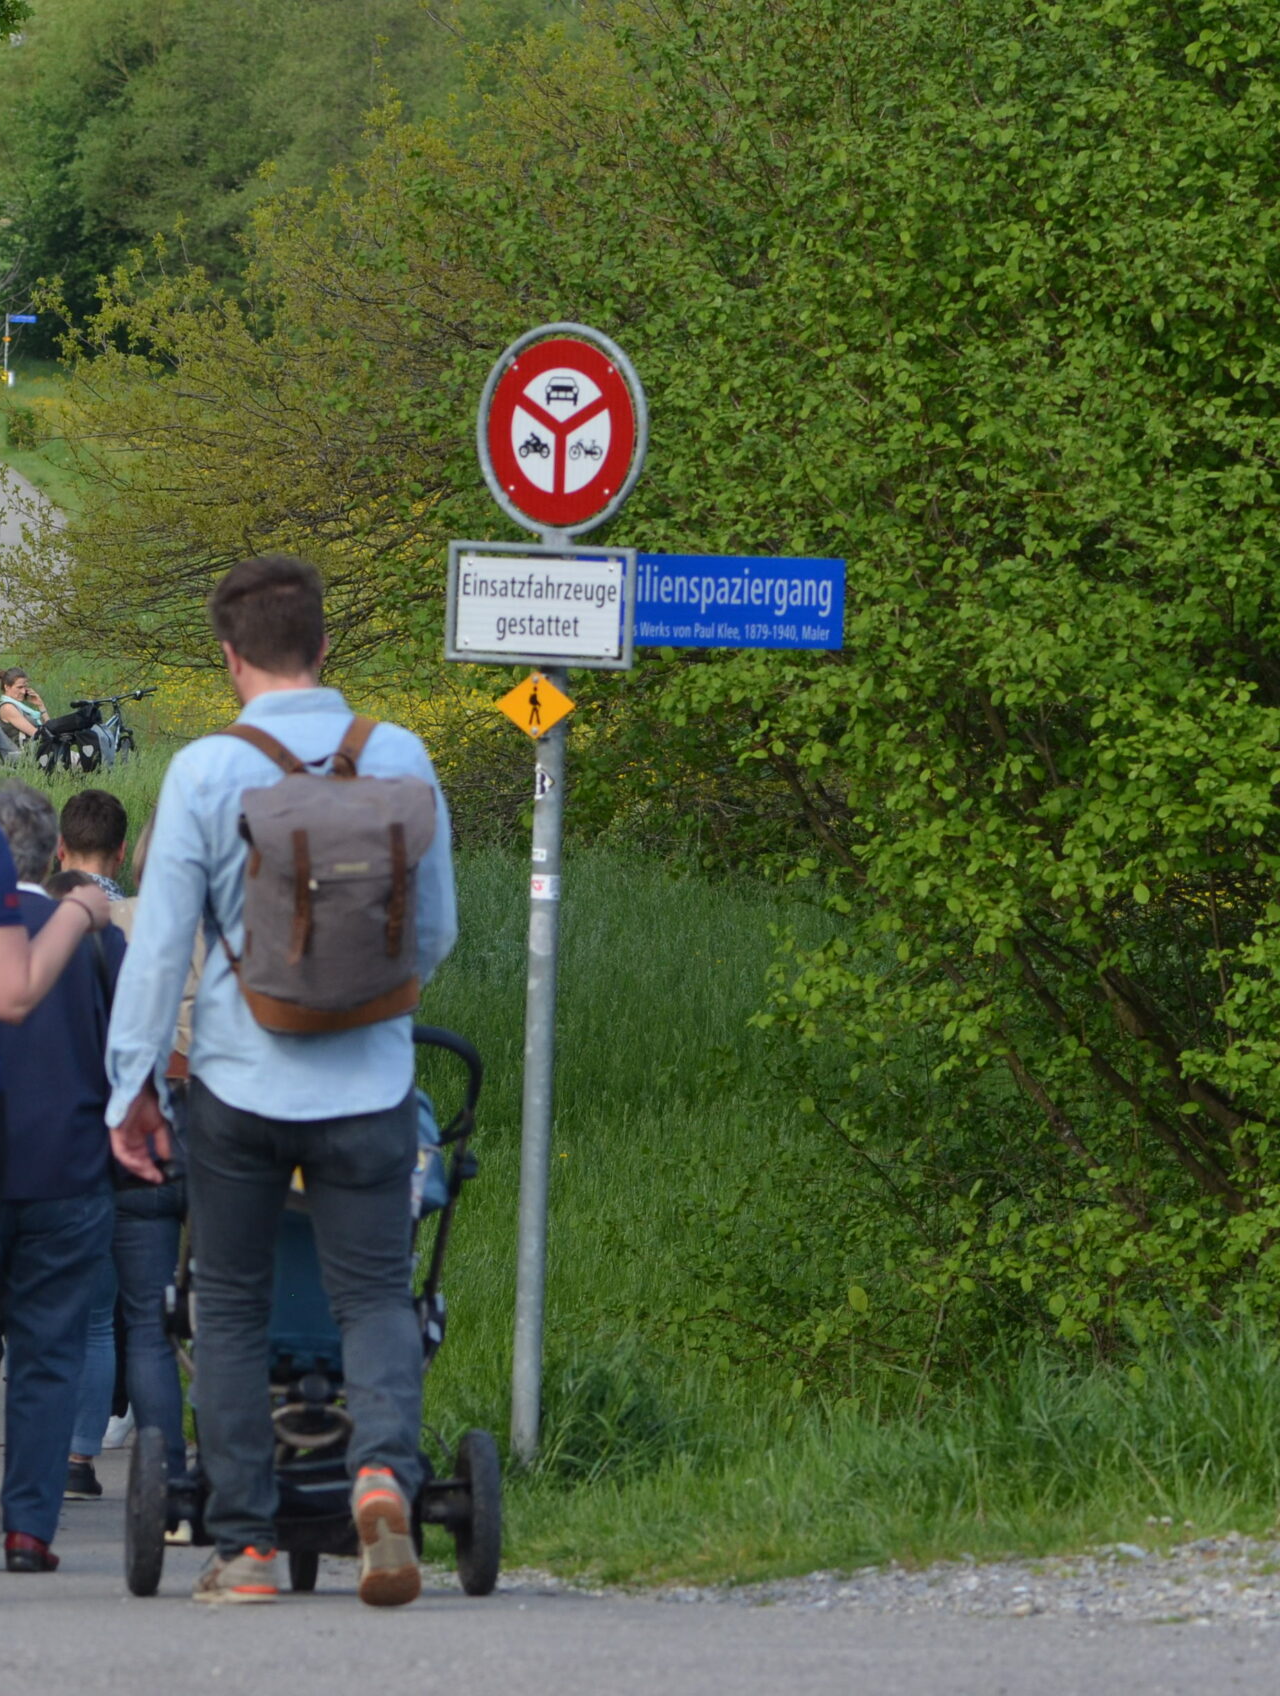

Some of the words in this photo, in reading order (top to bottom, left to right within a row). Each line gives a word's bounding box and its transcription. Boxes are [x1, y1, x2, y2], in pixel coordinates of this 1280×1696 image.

[462, 573, 617, 608] Einsatzfahrzeuge
[622, 564, 832, 617] ilienspaziergang
[496, 614, 580, 641] gestattet
[640, 621, 670, 638] Werks
[673, 626, 692, 638] von
[694, 622, 715, 639] Paul
[717, 622, 740, 641] Klee,
[744, 624, 799, 642] 1879-1940,
[801, 625, 831, 641] Maler
